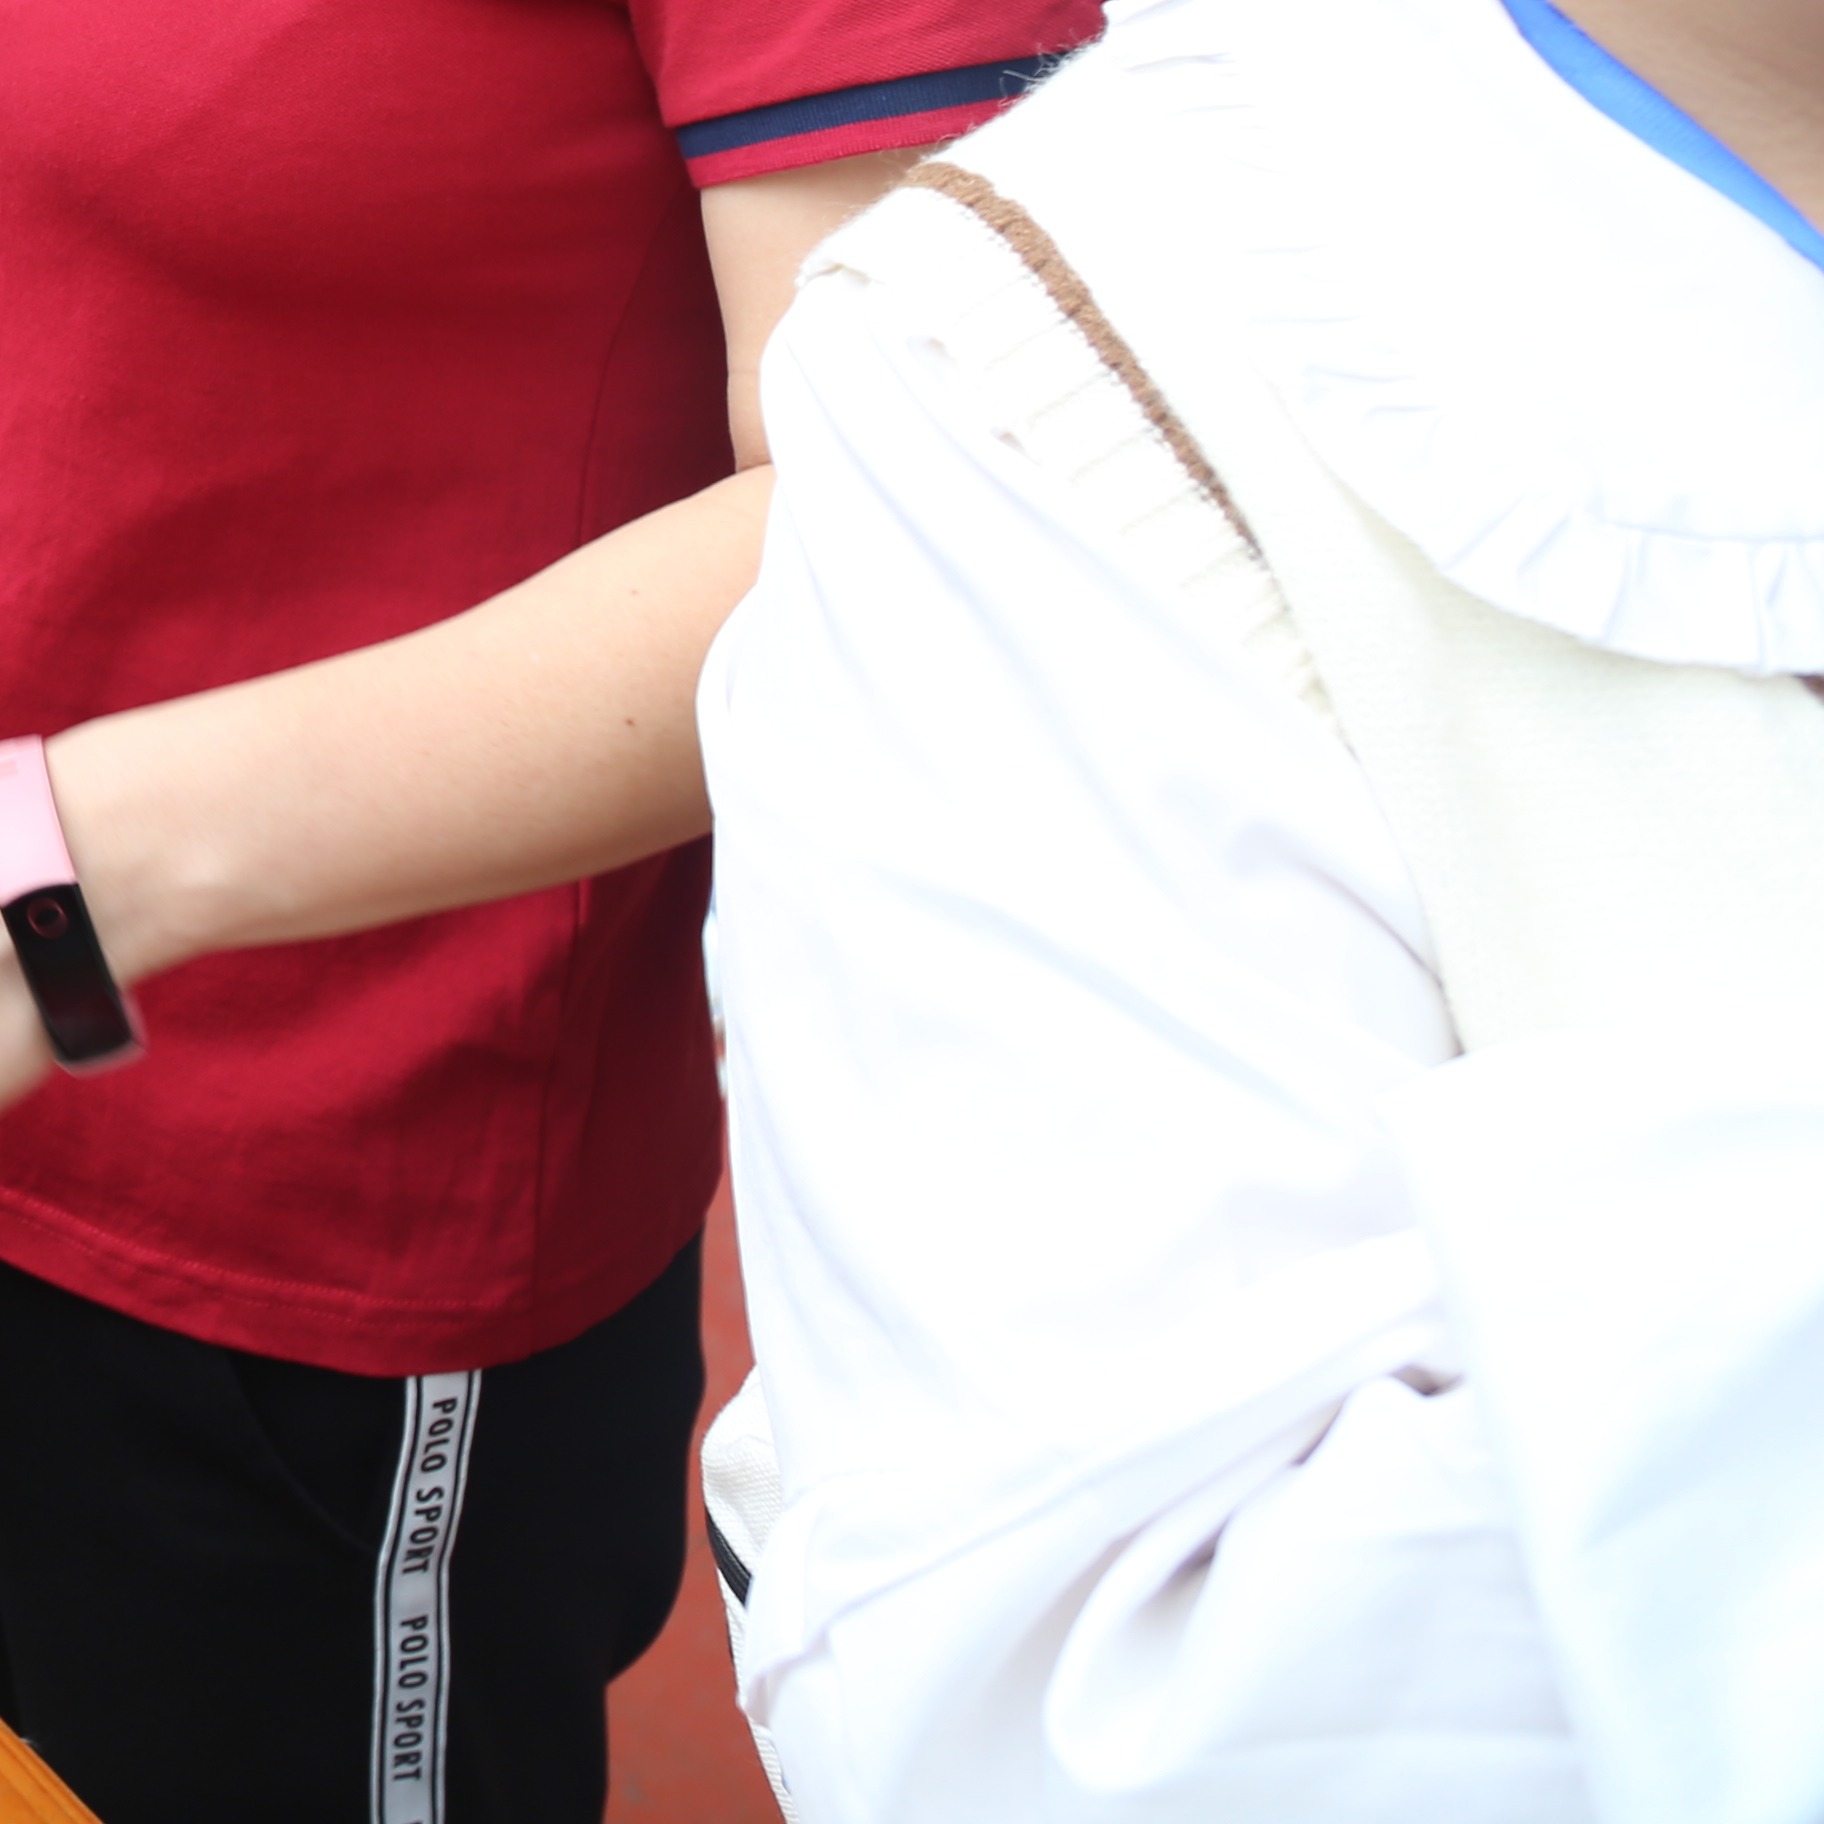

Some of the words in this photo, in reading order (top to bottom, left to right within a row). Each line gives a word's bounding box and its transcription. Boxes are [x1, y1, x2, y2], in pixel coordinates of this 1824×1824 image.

[419, 1397, 458, 1475] POLO
[402, 1485, 444, 1575] SPORT
[398, 1614, 428, 1690] POLO
[393, 1698, 425, 1781] SPORT
